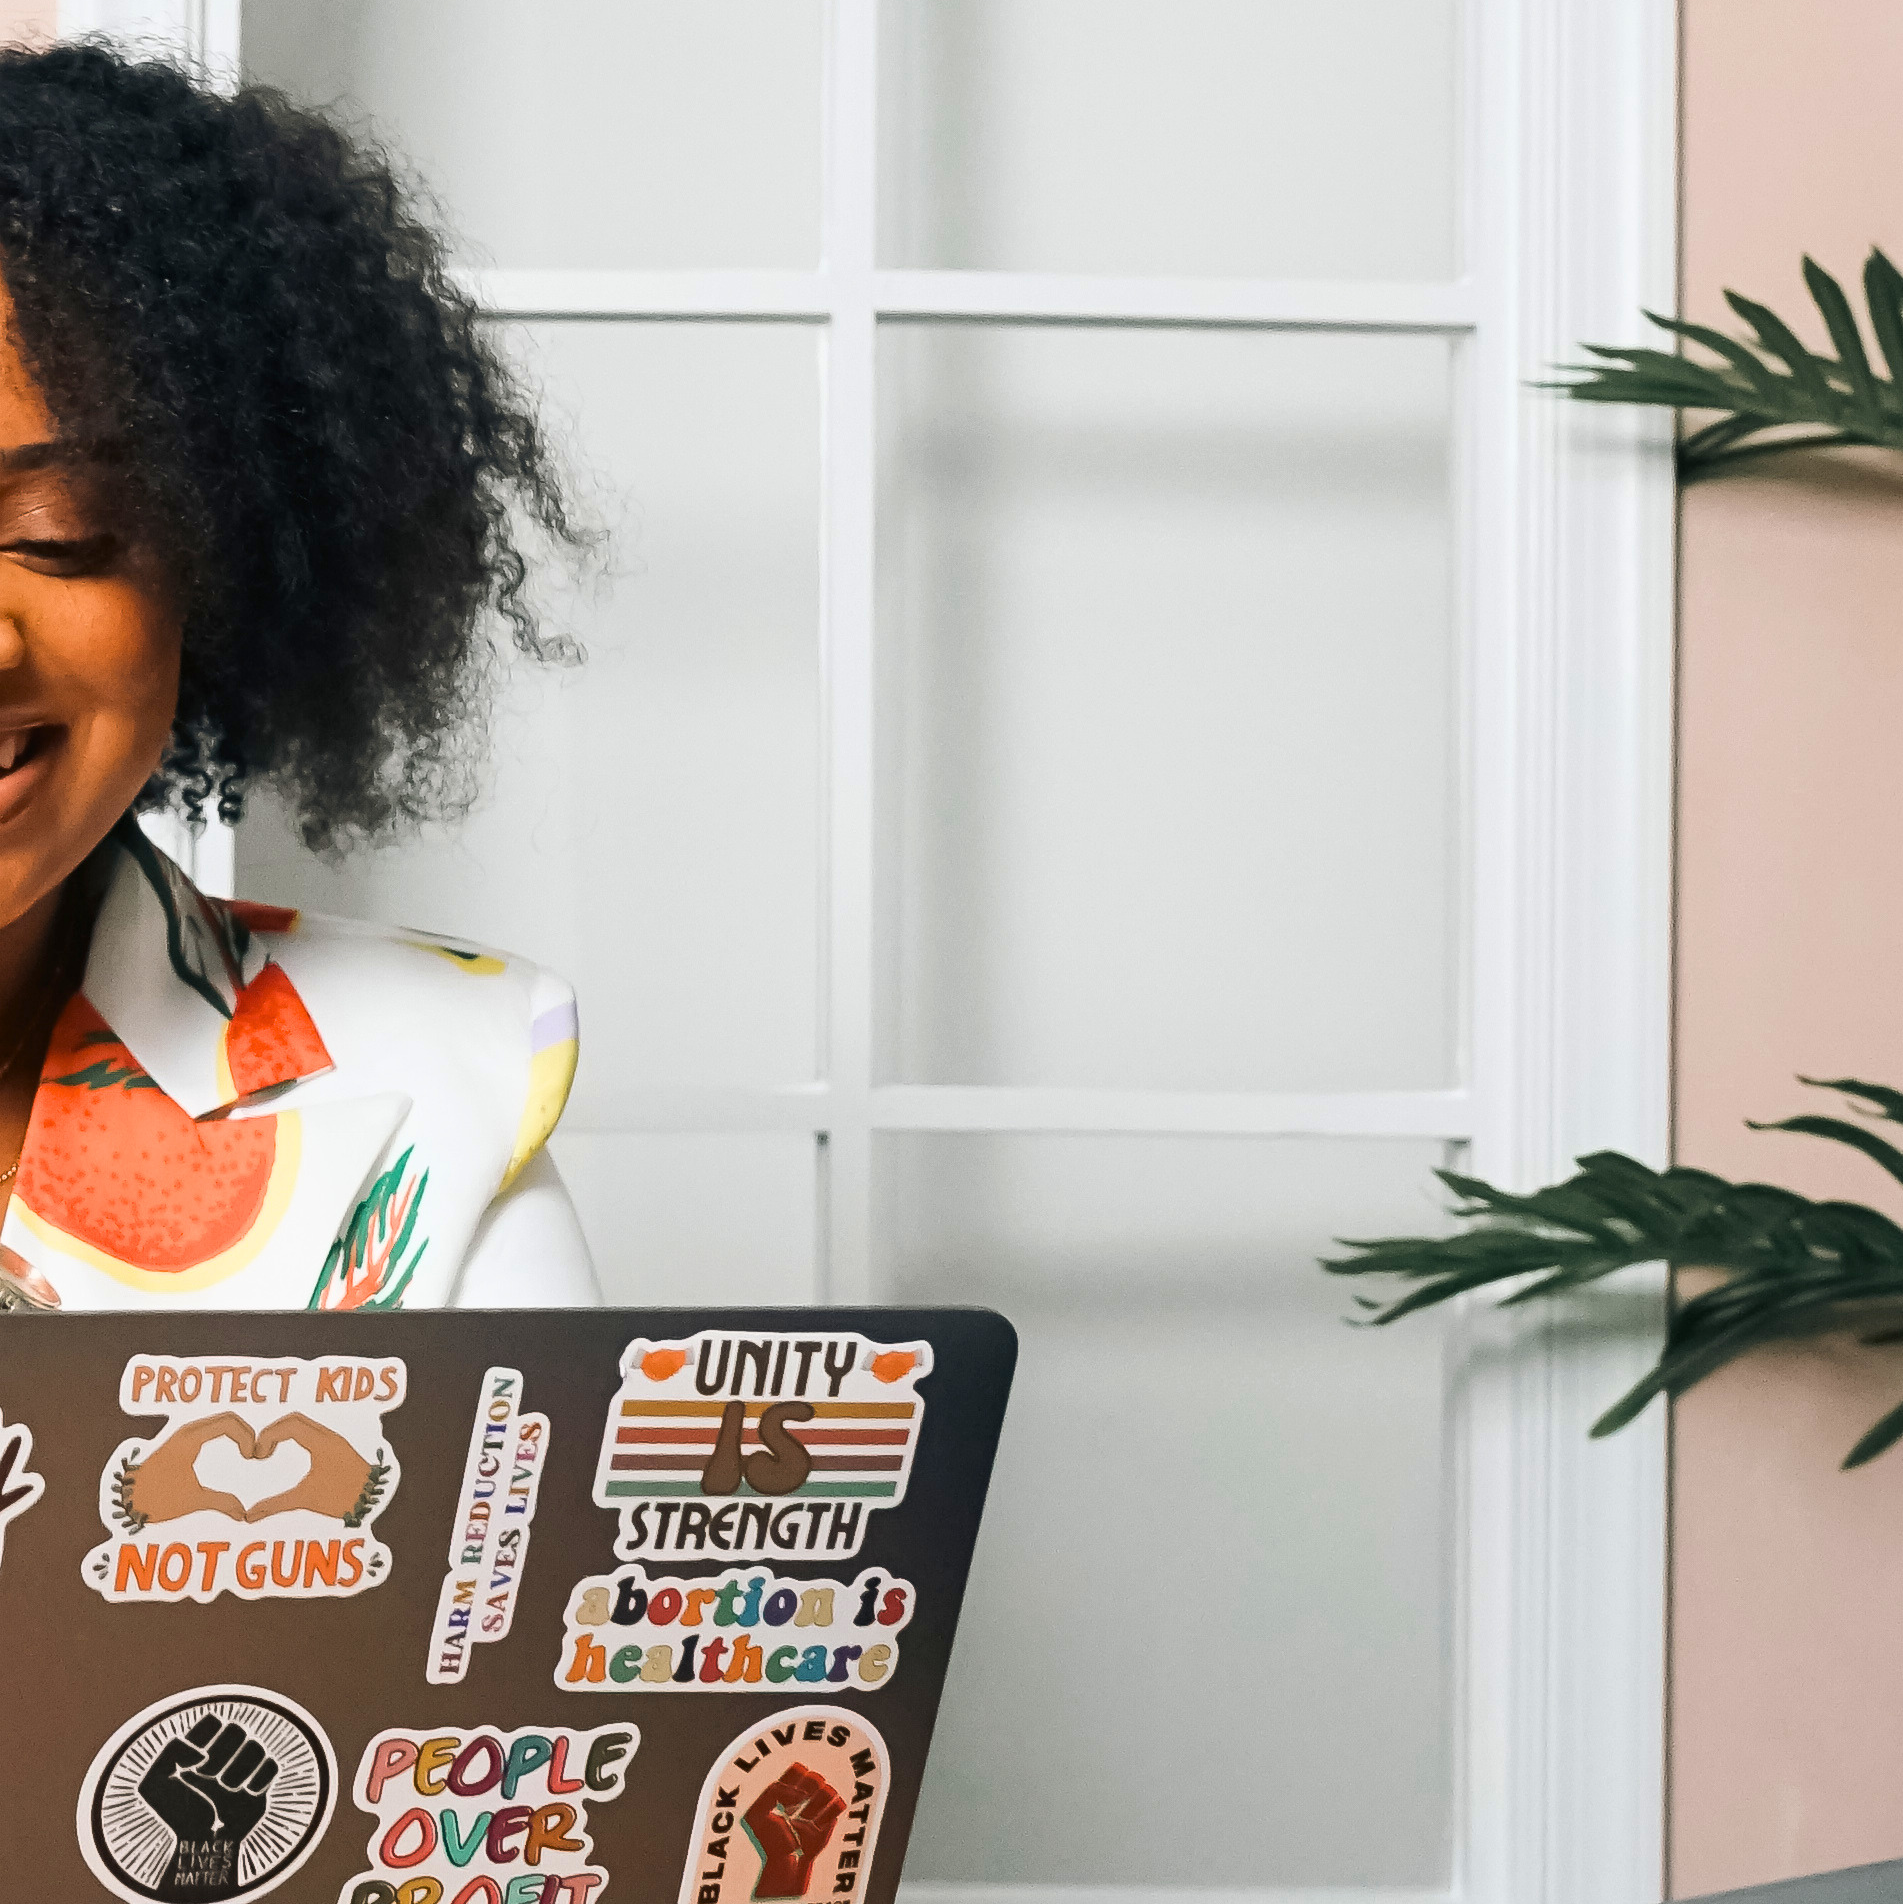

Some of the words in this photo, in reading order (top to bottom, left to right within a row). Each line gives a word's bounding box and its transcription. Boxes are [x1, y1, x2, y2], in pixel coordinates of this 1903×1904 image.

[131, 1365, 297, 1403] PROTECT
[315, 1365, 398, 1403] KIDS
[696, 1339, 857, 1397] UNITY
[700, 1400, 815, 1496] IS
[439, 1579, 477, 1675] HARM
[460, 1376, 516, 1564] REDUCTION
[481, 1528, 521, 1633] SAVES
[505, 1422, 542, 1515] LIVES
[626, 1502, 863, 1551] STRENGTH
[114, 1542, 230, 1592] NOT
[235, 1538, 365, 1590] GUNS
[575, 1577, 835, 1627] abortion
[853, 1577, 907, 1627] is
[565, 1634, 891, 1683] healthcare
[366, 1735, 633, 1804] PEOPLE
[379, 1802, 585, 1868] OVER
[698, 1785, 740, 1904] BLACK
[733, 1720, 851, 1773] LIVES
[832, 1748, 876, 1894] MATTER
[177, 1855, 232, 1870] LIVES
[179, 1840, 234, 1854] BLACK
[174, 1870, 229, 1886] MATTER
